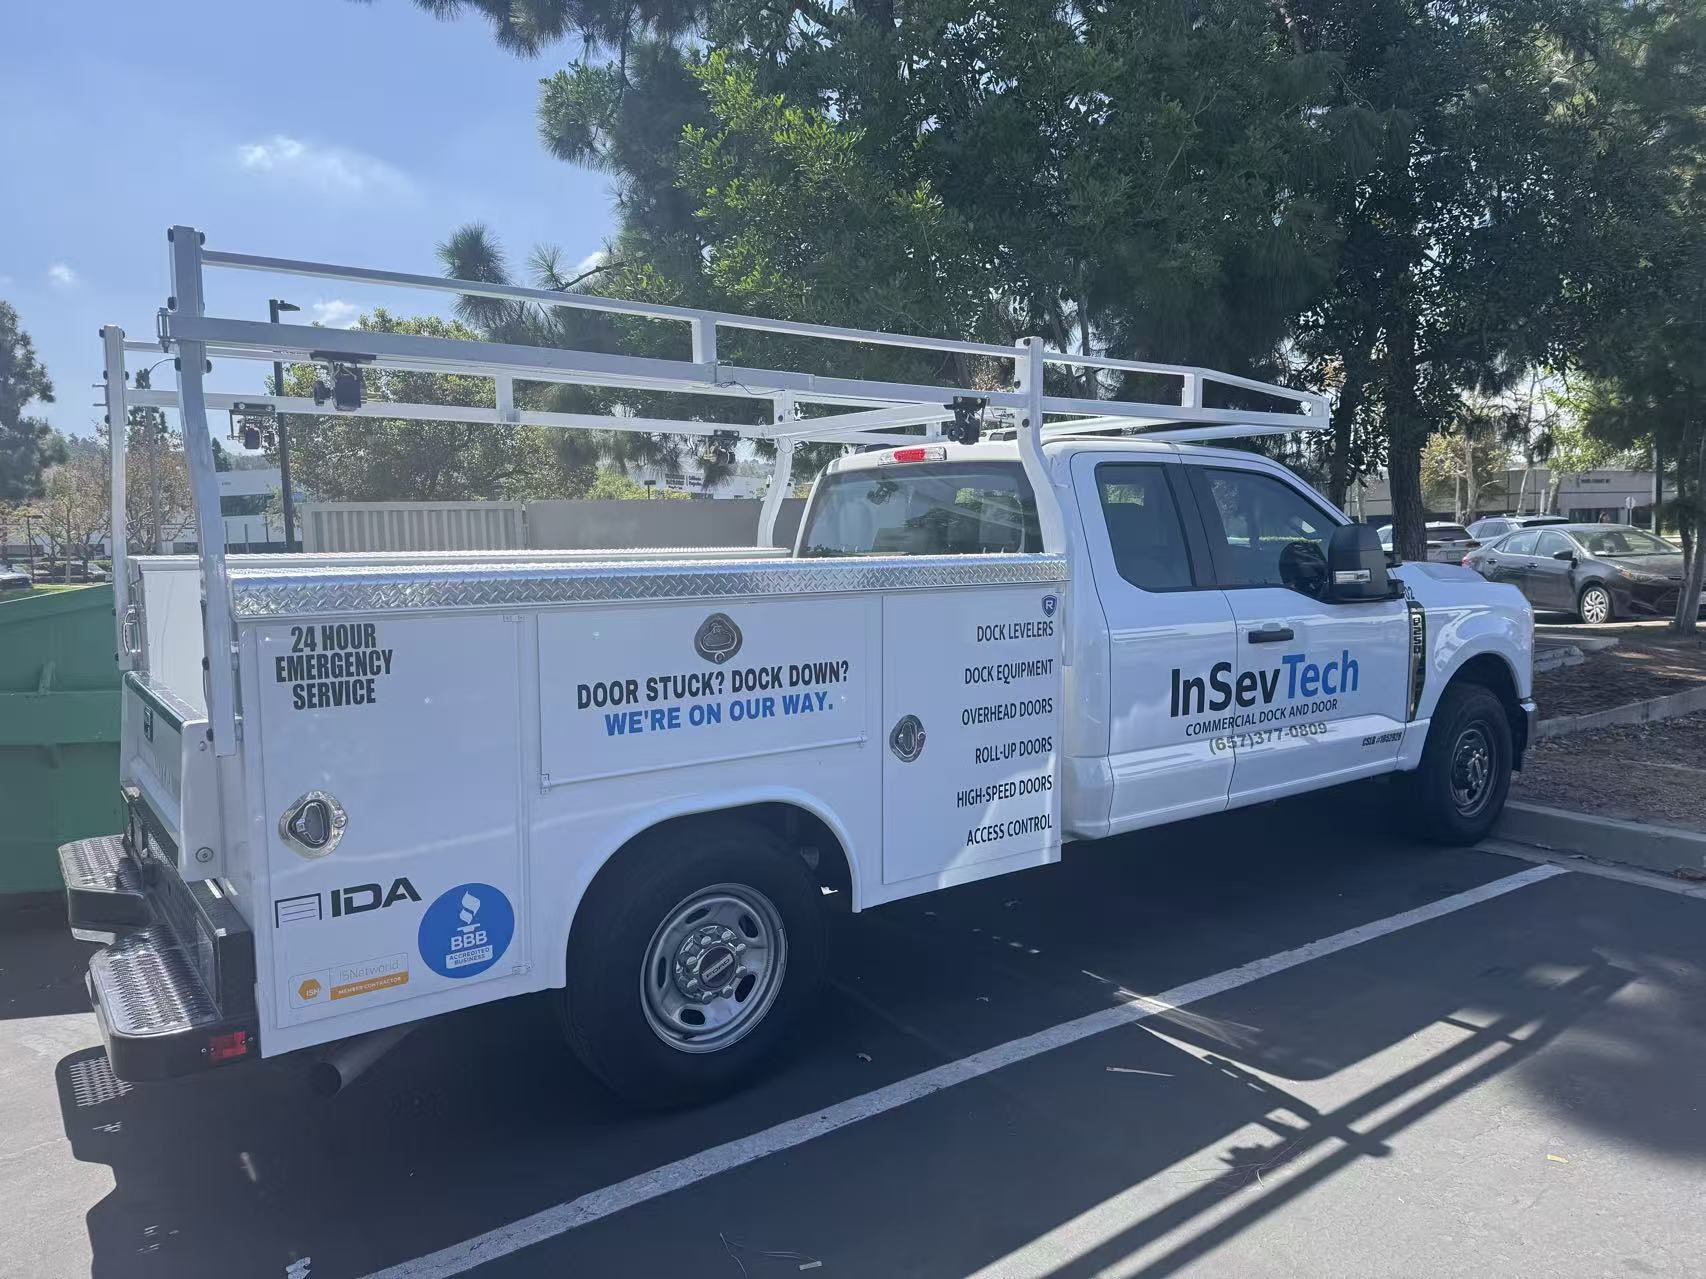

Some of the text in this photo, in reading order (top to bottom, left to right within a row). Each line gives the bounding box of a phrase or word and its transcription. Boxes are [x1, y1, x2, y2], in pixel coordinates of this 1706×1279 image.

[1045, 600, 1053, 610] R
[291, 623, 376, 653] 24 HOUR
[977, 620, 1054, 643] DOCK LEVELERS
[275, 649, 393, 683] EMERGENCY
[965, 658, 1054, 685] DOCK EQUIPMENT
[292, 679, 376, 711] SERVICE
[577, 660, 849, 710] DOOR STUCK? DOCK DOWN?
[1169, 649, 1359, 718] InSevTech
[604, 691, 833, 737] WE'RE ON OUR WAY.
[962, 697, 1053, 726] OVERHEAD DOORS
[1185, 698, 1338, 737] COMMERCIAL DOCK AND DOOR
[975, 735, 1053, 765] ROLL-UP DOORS
[1208, 722, 1328, 756] (657)377-0809
[957, 774, 1053, 808] HIGH-SPEED DOORS
[966, 814, 1053, 846] ACCESS CONTROL
[330, 877, 421, 917] IDA
[449, 947, 490, 961] ACCREDITED
[450, 930, 488, 951] BBB
[454, 953, 486, 966] BUSINESS
[705, 958, 729, 977] FORD
[305, 986, 321, 998] ISN
